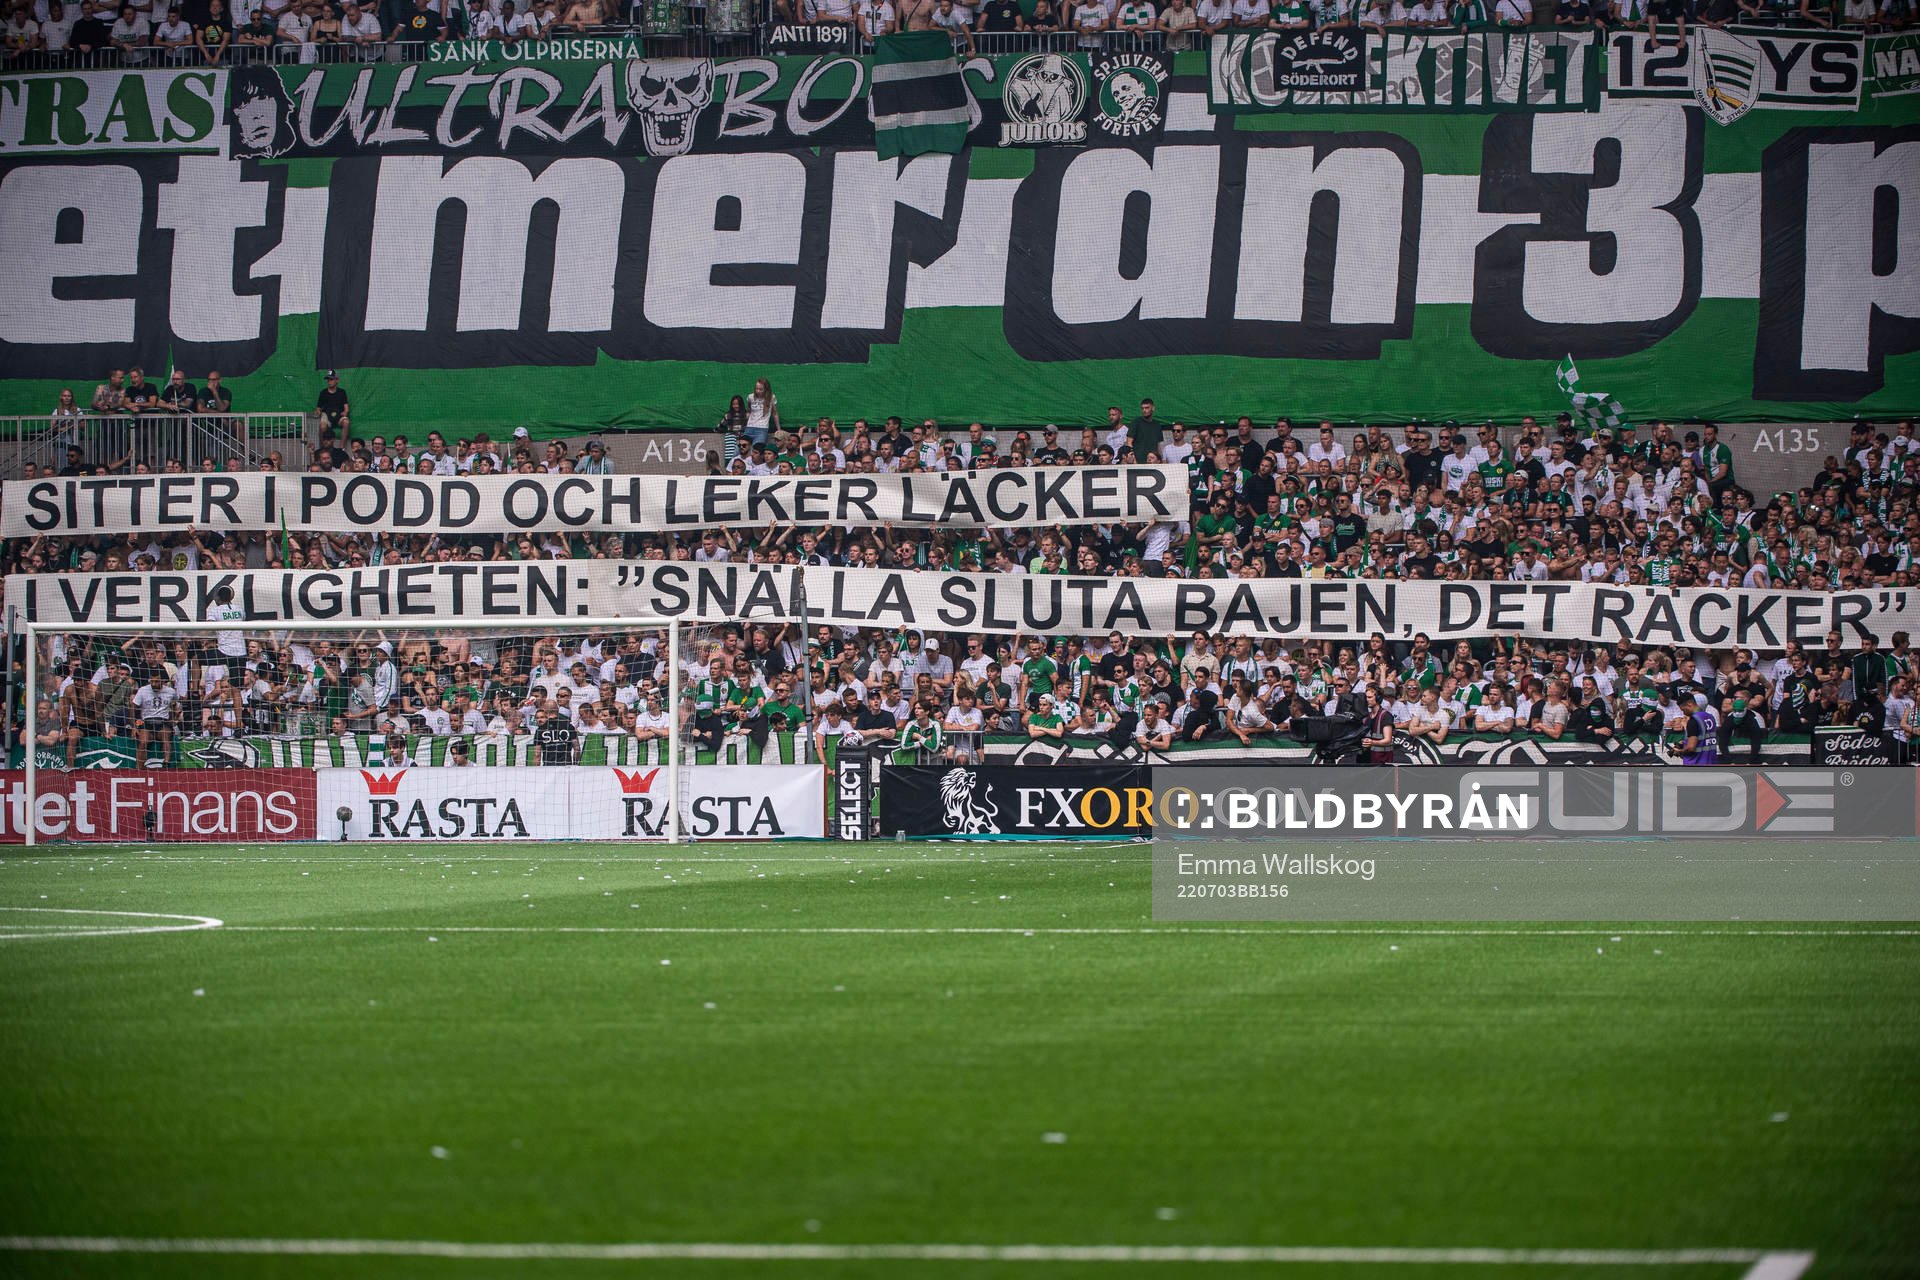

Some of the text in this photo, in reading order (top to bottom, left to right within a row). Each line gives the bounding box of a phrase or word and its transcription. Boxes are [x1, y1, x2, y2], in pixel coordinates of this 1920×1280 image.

[770, 25, 847, 44] ANTI 1891
[1281, 31, 1358, 60] DEFEND
[430, 39, 489, 62] SÄNK
[1613, 35, 1689, 87] 12
[1094, 53, 1168, 83] SPJUVERN
[1211, 31, 1595, 106] KOEKTIVET
[1280, 71, 1357, 86] SÖDERORT
[297, 64, 630, 150] ULTRA
[1697, 89, 1749, 121] HAMMARBY STHLM
[999, 121, 1087, 147] JUNIORS
[1093, 112, 1162, 137] FOREVER
[642, 438, 708, 463] A136
[1753, 428, 1820, 454] A135
[25, 468, 1170, 531] SITTER I PODD OCH LEKER LÄCKER
[26, 579, 37, 622] I
[58, 564, 589, 622] VERKLIGHETEN:
[937, 575, 1151, 631] SLUTA
[1175, 583, 1413, 638] BAJEN,
[1439, 583, 1571, 632] DET
[541, 729, 570, 743] SLO
[1825, 733, 1881, 751] Söder
[111, 777, 298, 835] Finans
[840, 760, 861, 840] SELECT
[368, 797, 530, 837] RASTA
[622, 796, 785, 837] RASTA
